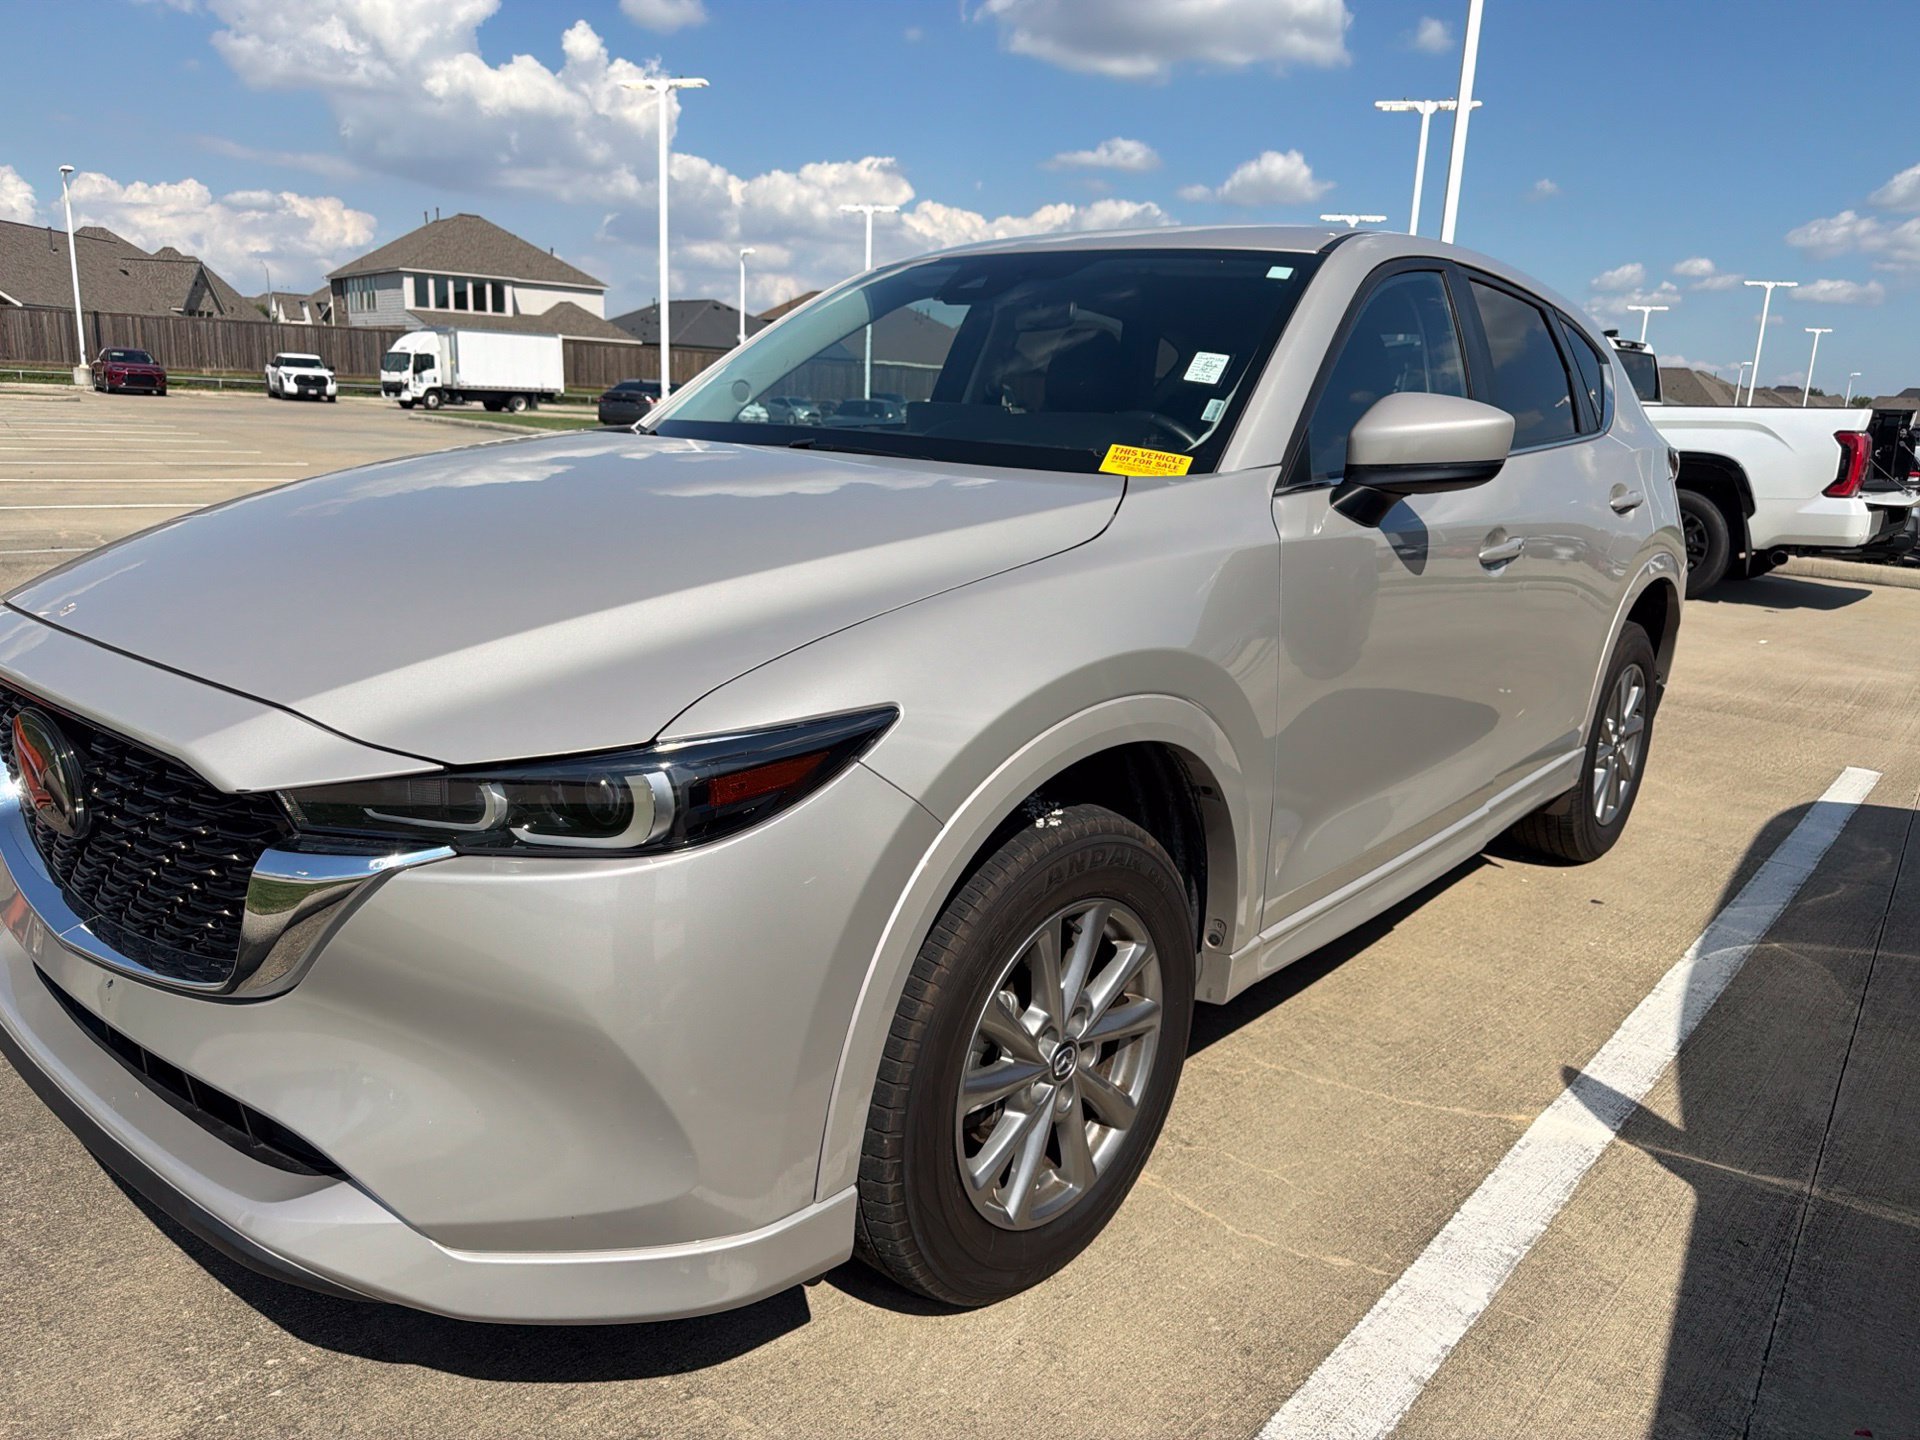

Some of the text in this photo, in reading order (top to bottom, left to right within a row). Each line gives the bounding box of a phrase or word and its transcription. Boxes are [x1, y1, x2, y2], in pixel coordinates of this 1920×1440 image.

[1112, 454, 1130, 462] NOT
[1133, 458, 1153, 466] FOR
[1155, 461, 1181, 470] SALE
[1114, 447, 1186, 465] THIS VEHICLE
